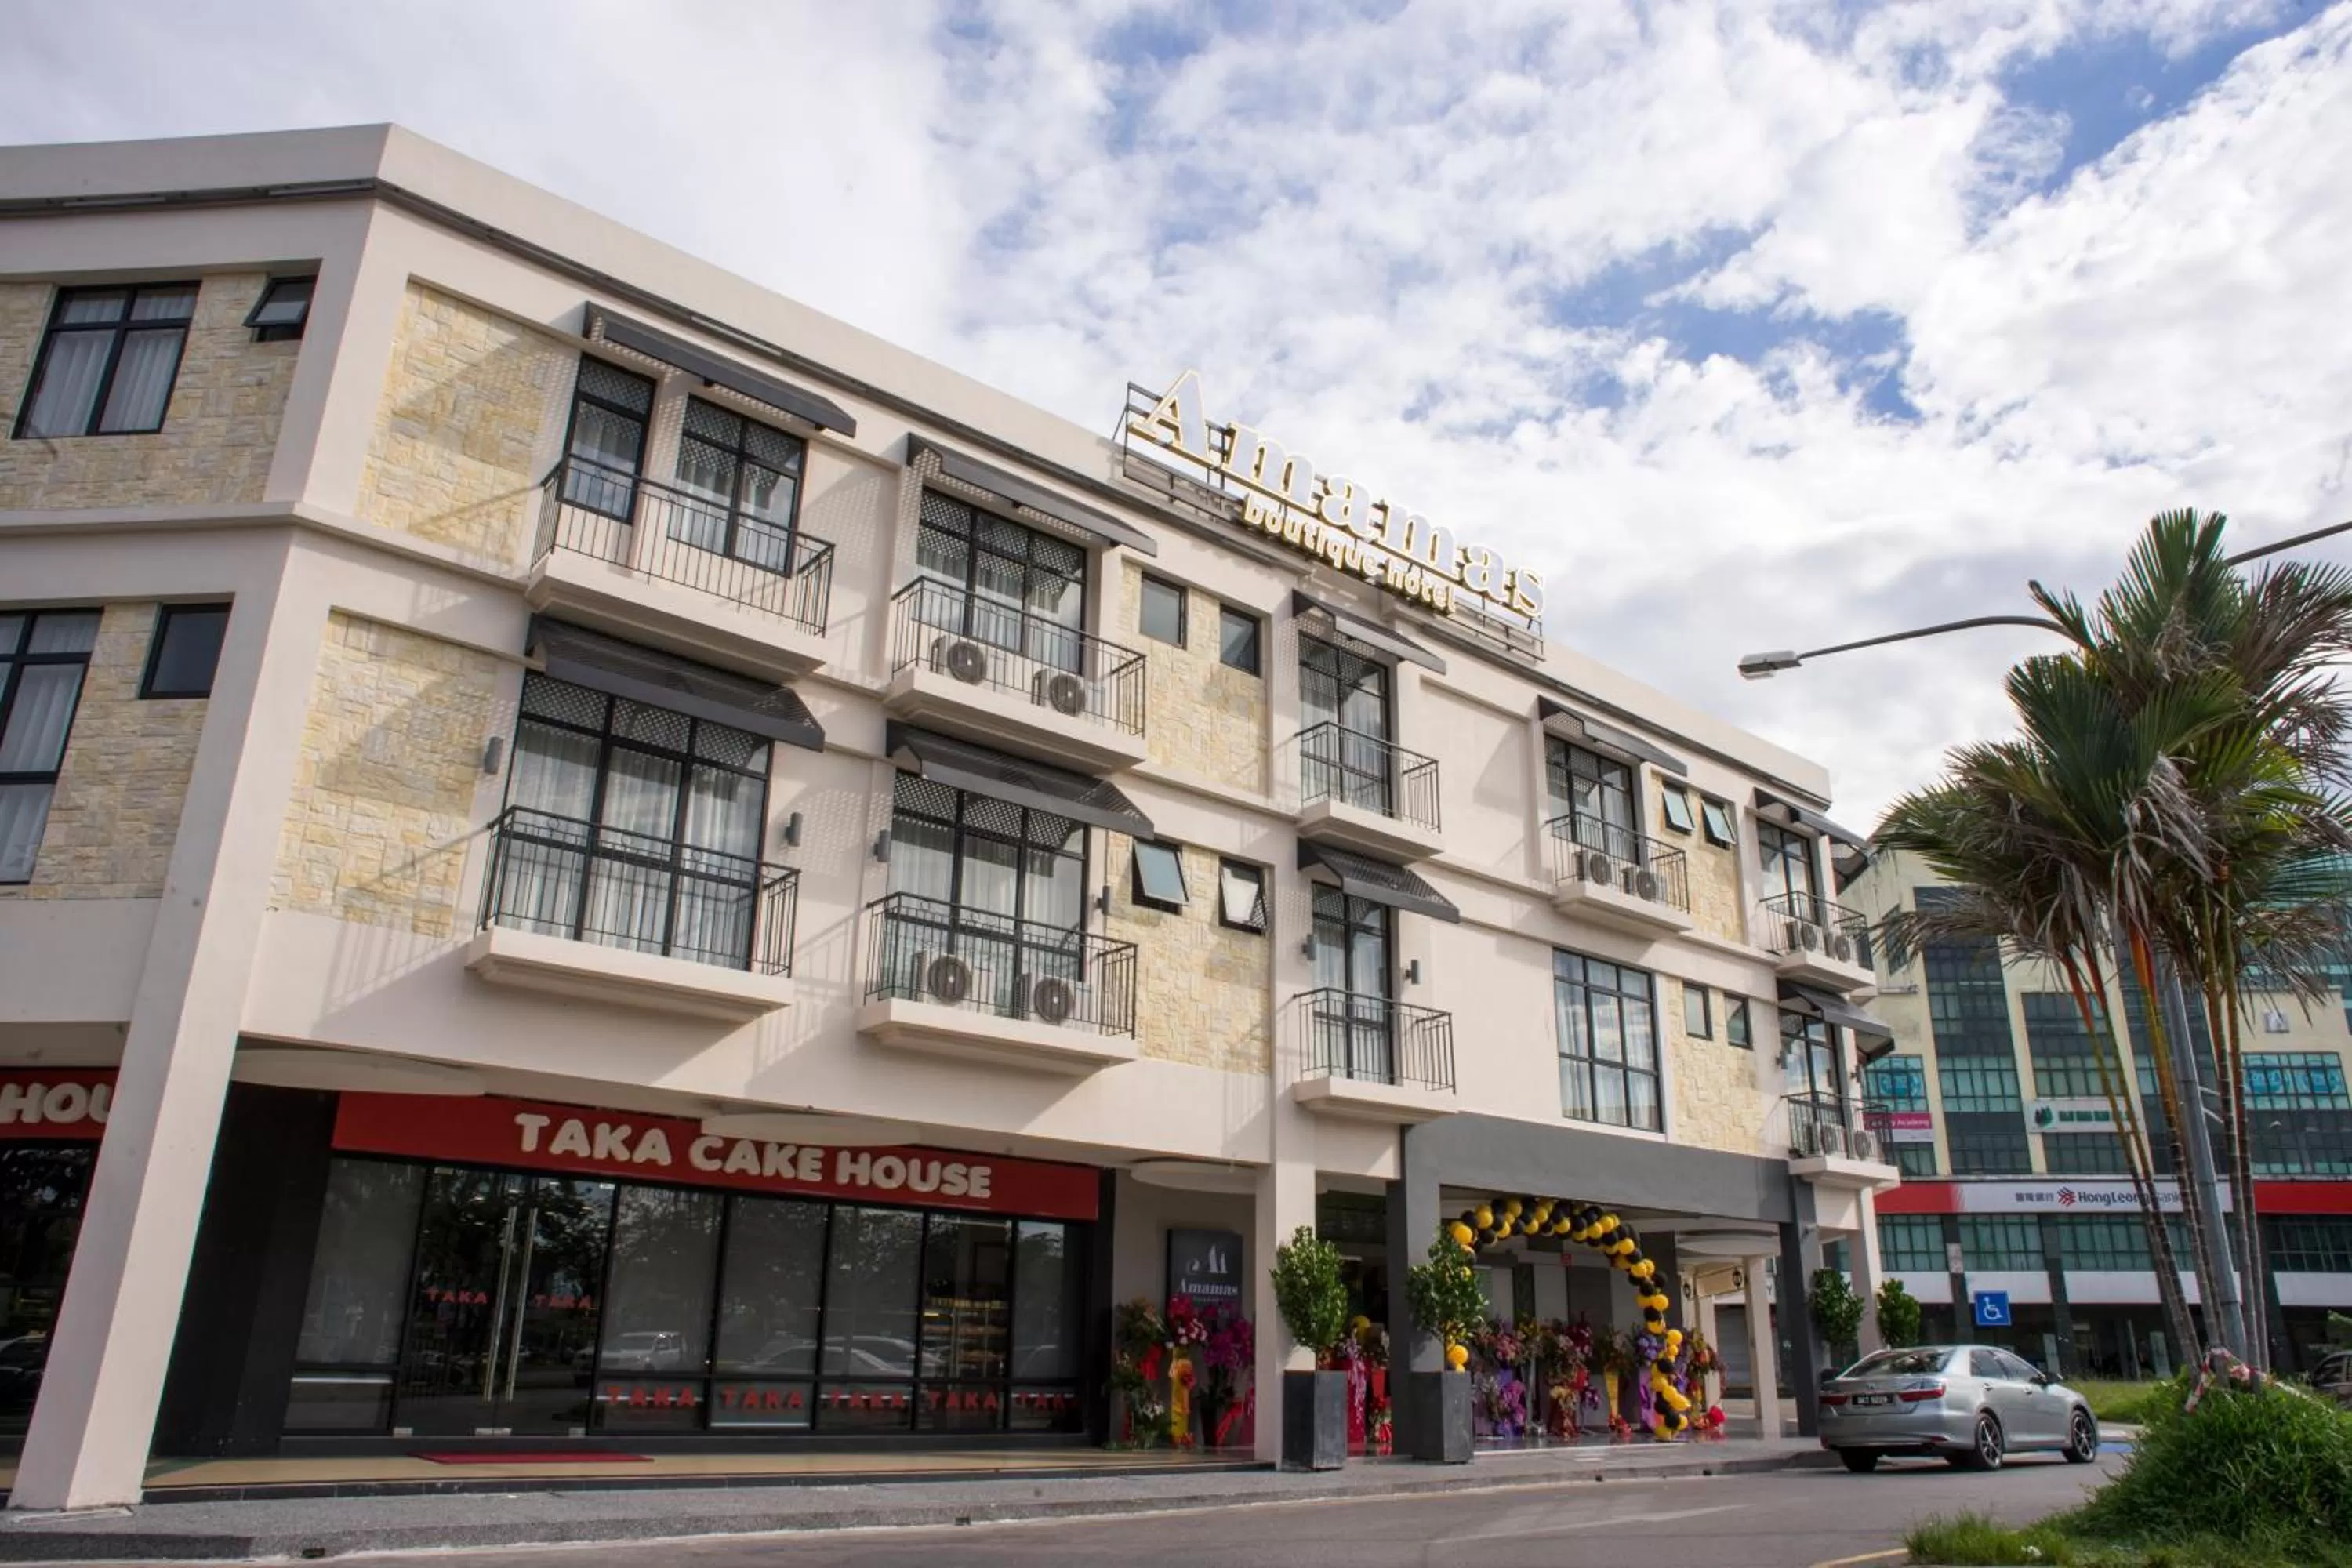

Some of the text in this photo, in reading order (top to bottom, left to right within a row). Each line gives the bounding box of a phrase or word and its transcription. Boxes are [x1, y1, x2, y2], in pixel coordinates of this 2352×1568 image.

[1127, 369, 1546, 618] Amamas
[1242, 491, 1457, 615] boutique hotel
[514, 1112, 992, 1199] TAKA CAKE HOUSE
[426, 1286, 488, 1305] TAKA
[608, 1385, 696, 1406] TAKA
[720, 1387, 804, 1408] TAKA
[830, 1388, 906, 1408] TAKA
[927, 1392, 999, 1409] TAKA
